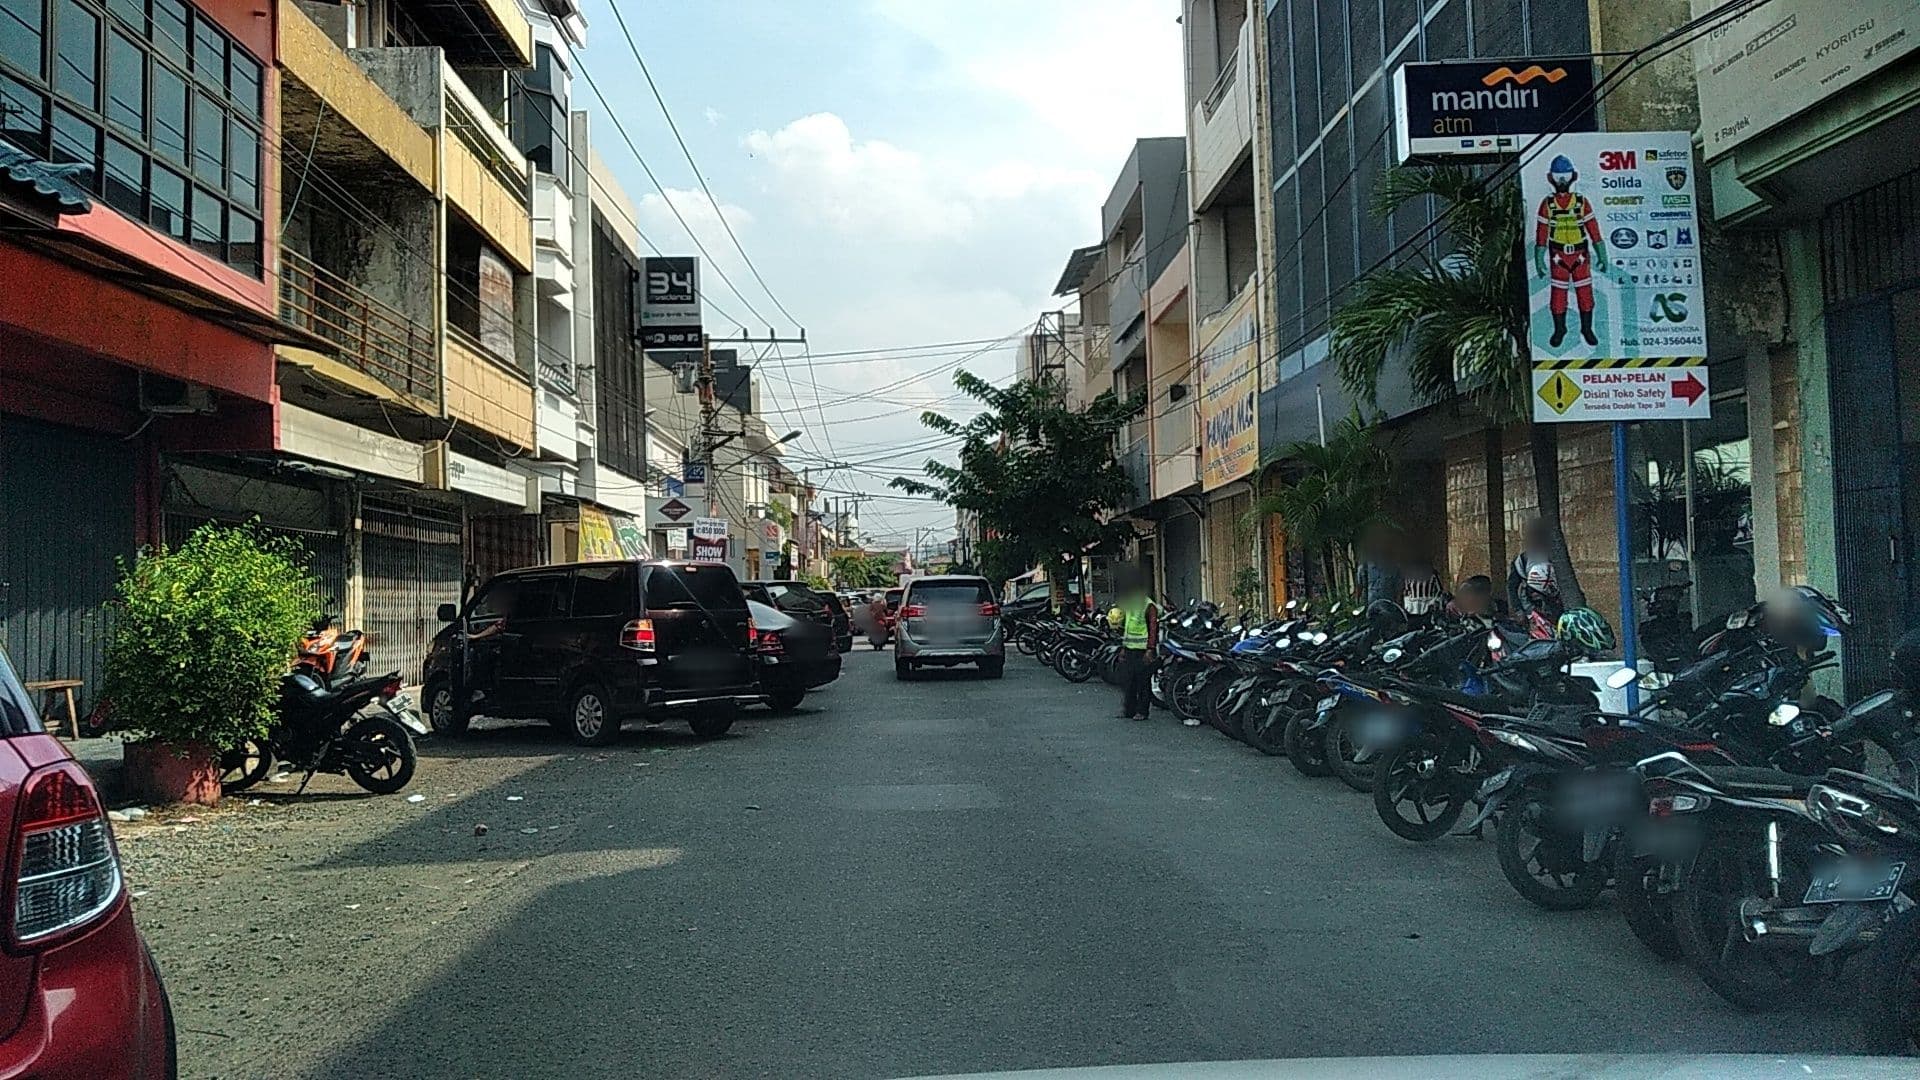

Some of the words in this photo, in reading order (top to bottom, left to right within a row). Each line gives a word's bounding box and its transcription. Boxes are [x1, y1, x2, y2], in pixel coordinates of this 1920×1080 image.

[1816, 18, 1875, 59] KYORITSU
[1432, 82, 1539, 111] mandiri
[1433, 116, 1473, 134] atm
[1721, 116, 1750, 138] Raytek
[1599, 151, 1637, 170] 3M
[1601, 176, 1642, 189] Solida
[650, 272, 691, 294] 34
[1642, 336, 1703, 346] 024-3560445
[1582, 373, 1666, 384] PELAN-PELAN
[1583, 389, 1610, 399] Disini
[1614, 389, 1635, 398] Toko
[1637, 388, 1666, 399] Safety
[696, 545, 723, 557] SHOW
